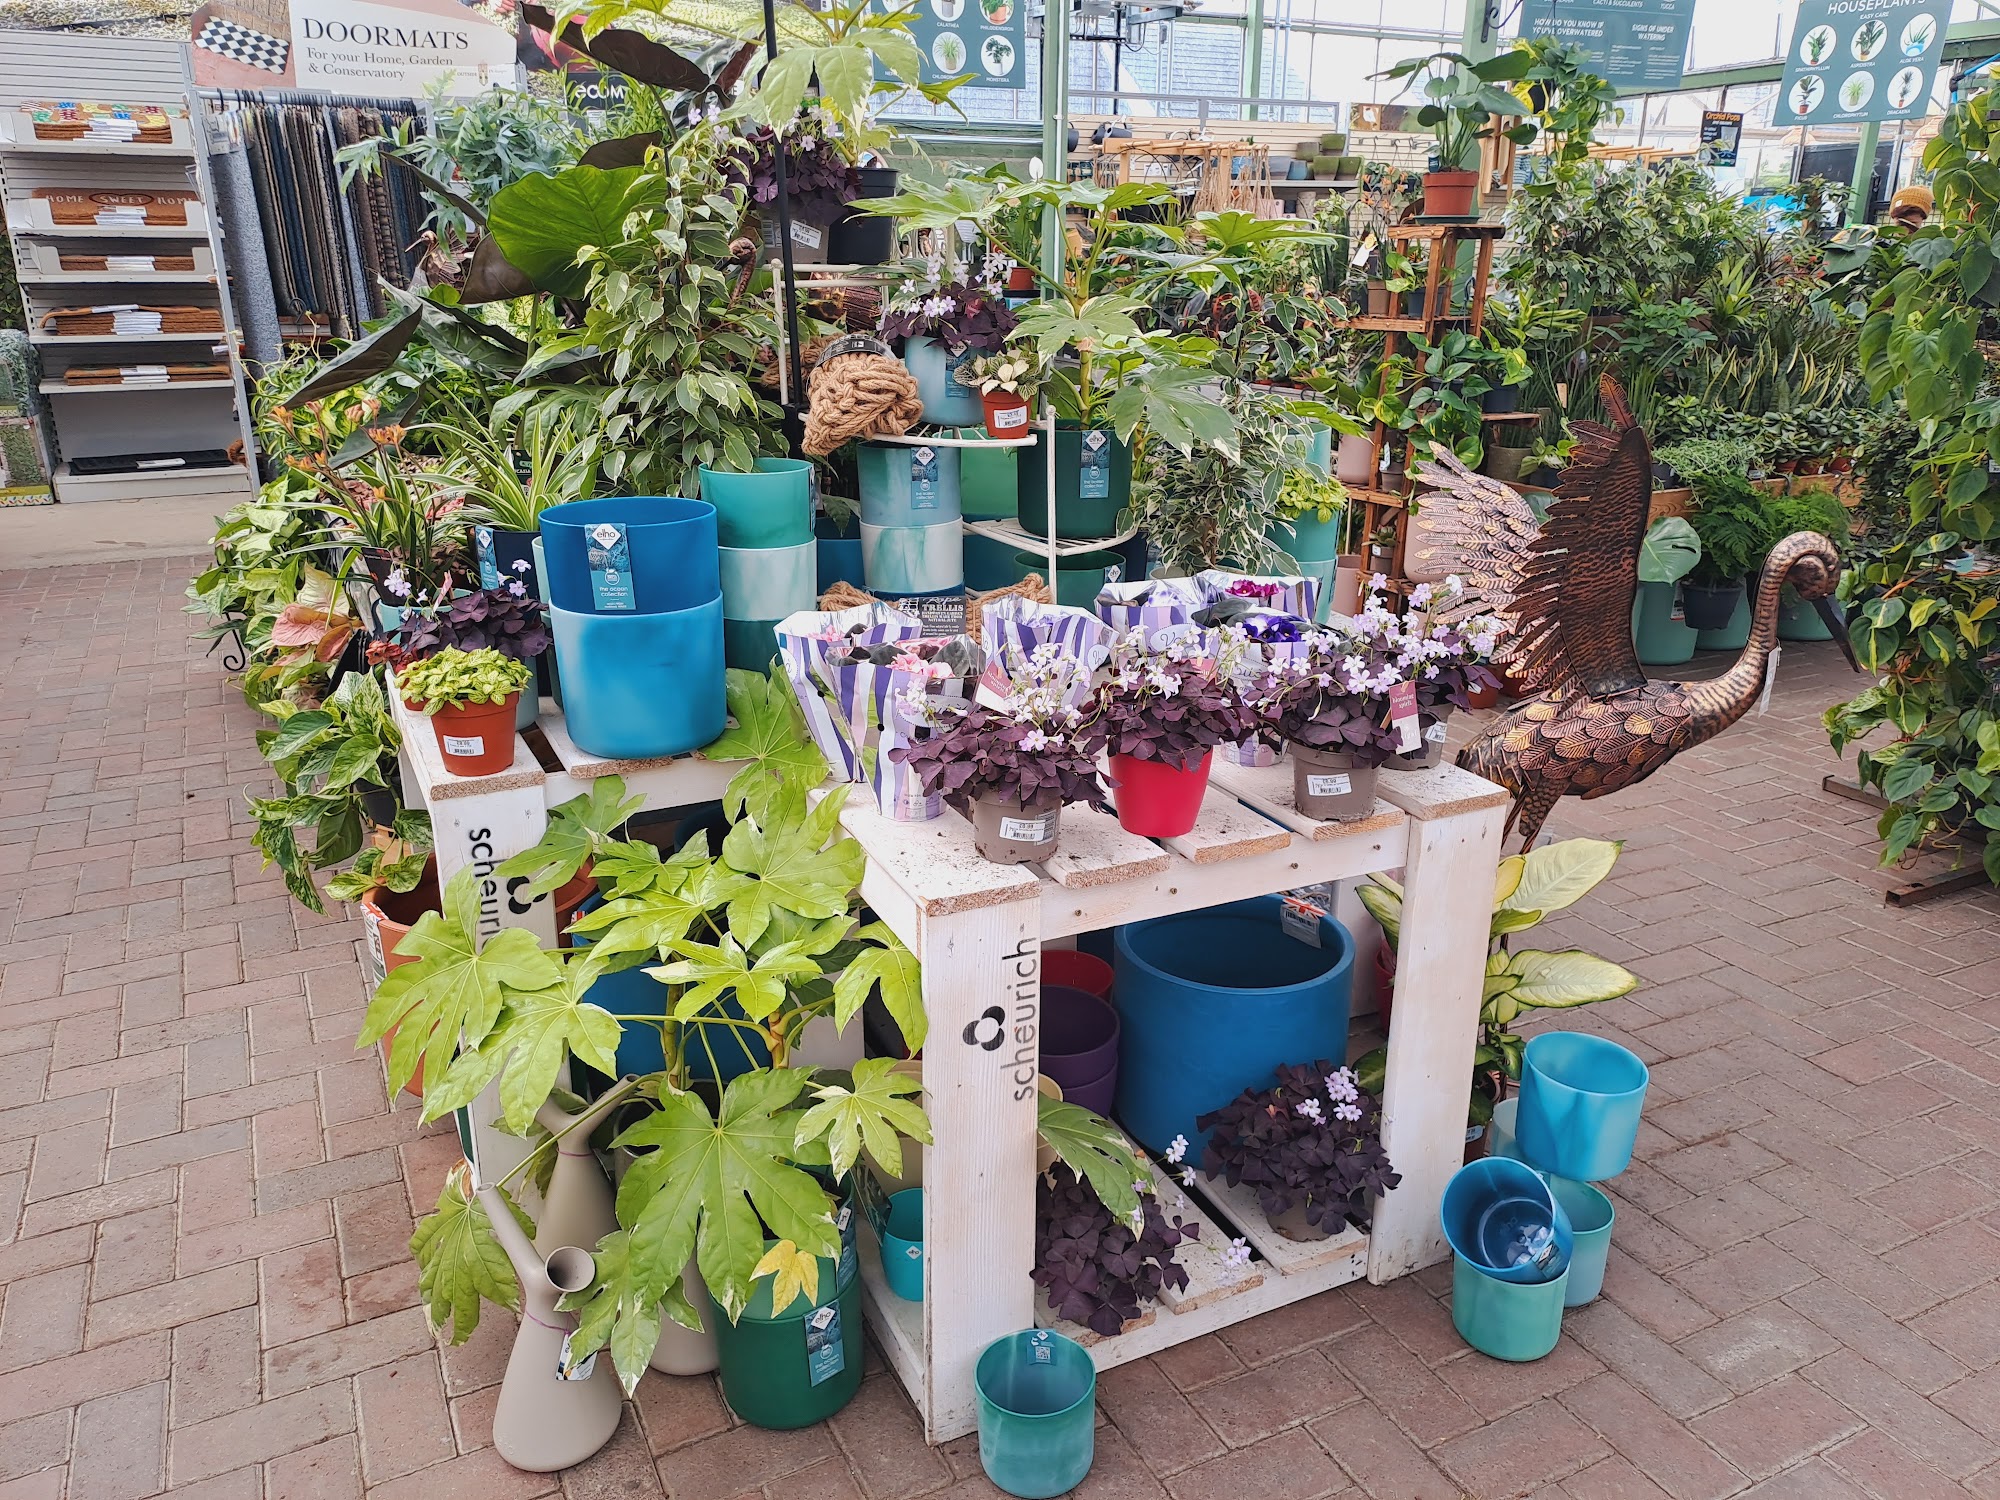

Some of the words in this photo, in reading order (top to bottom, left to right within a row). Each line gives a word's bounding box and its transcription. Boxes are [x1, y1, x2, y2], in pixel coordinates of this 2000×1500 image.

[1875, 11, 1889, 19] CARE
[1534, 18, 1551, 26] HOW
[1563, 20, 1576, 28] YOU
[1577, 21, 1597, 29] KNOW
[1598, 21, 1605, 29] IF
[1632, 24, 1648, 32] SIGNS
[1648, 25, 1657, 33] OF
[1657, 25, 1675, 33] UNDER
[302, 17, 469, 50] DOORMATS
[1557, 28, 1604, 38] OVERWATERED
[1638, 33, 1666, 42] WATERING
[307, 47, 329, 60] For
[331, 51, 360, 64] your
[364, 52, 405, 66] Home,
[409, 54, 453, 66] Garden
[308, 63, 320, 73] &
[324, 63, 405, 81] Conservatory
[100, 195, 144, 204] SWEET
[597, 528, 616, 538] elho
[921, 604, 964, 612] TRELLIS
[1000, 937, 1037, 1102] scheurich
[815, 1311, 832, 1324] elho
